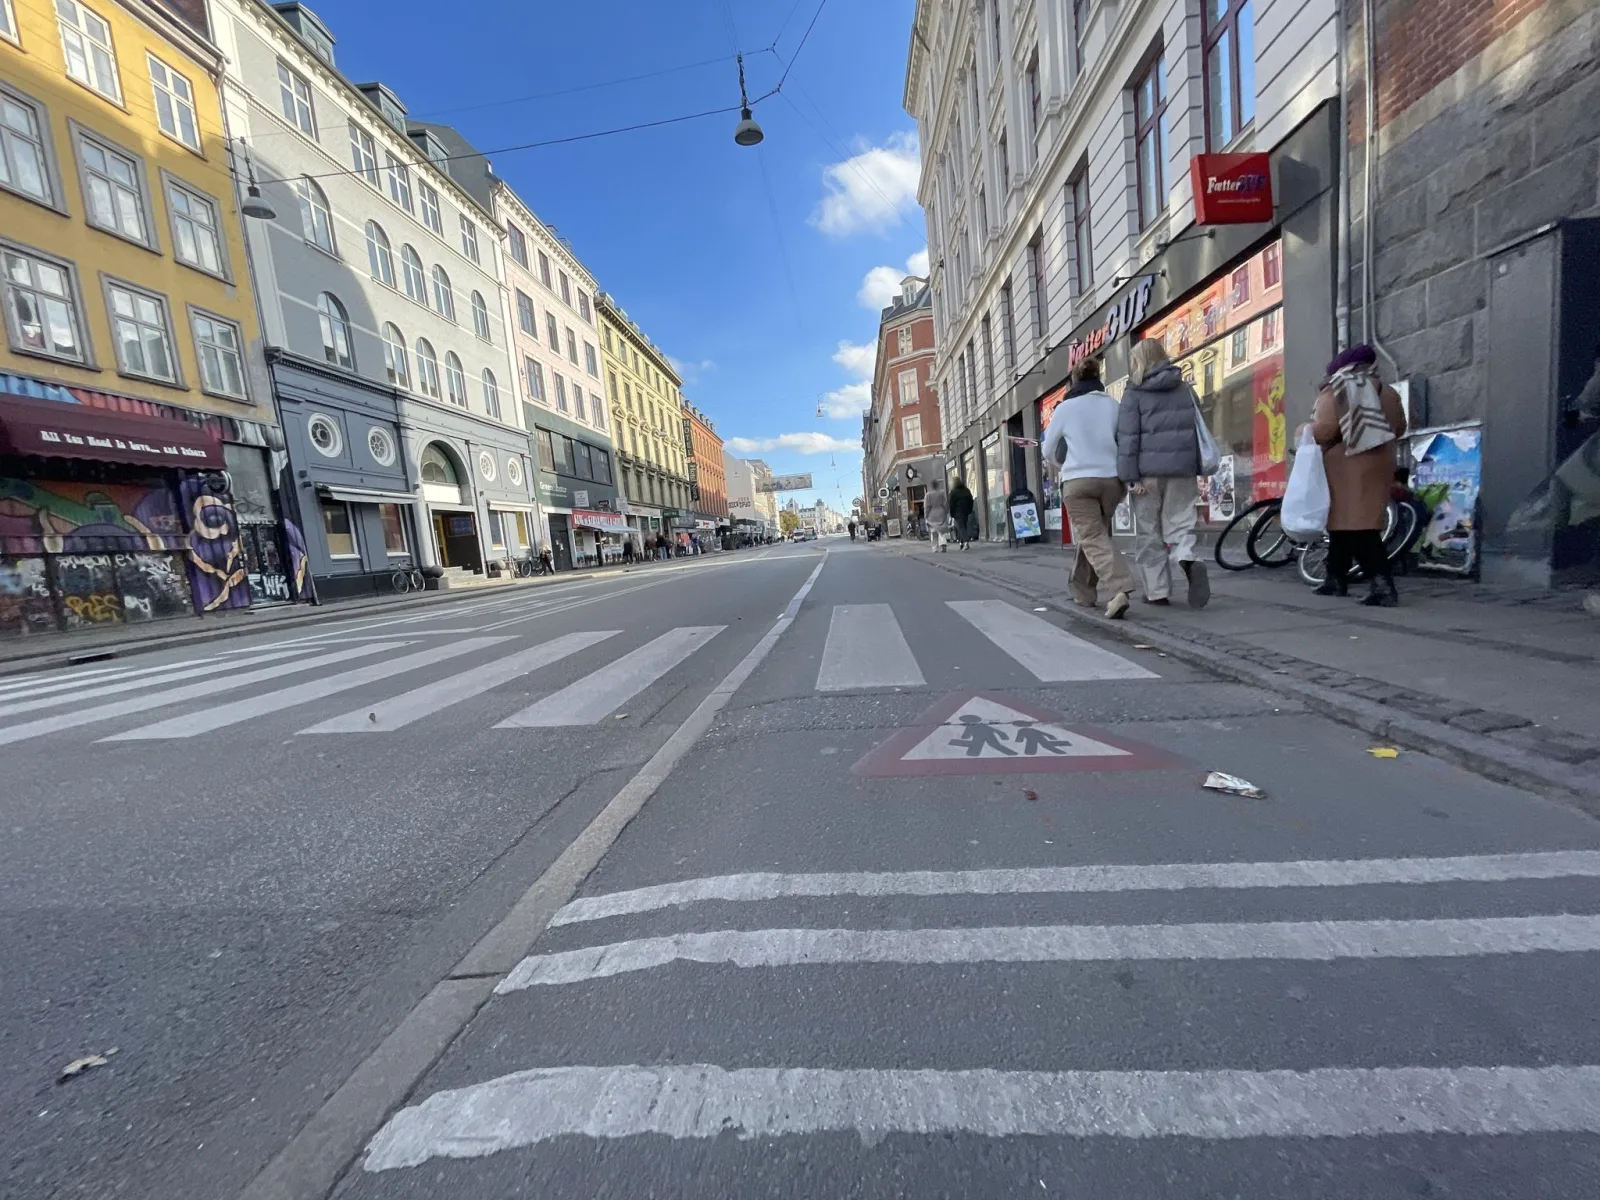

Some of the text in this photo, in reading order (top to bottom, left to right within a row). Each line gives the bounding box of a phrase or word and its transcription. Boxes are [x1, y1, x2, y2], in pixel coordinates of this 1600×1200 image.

[63, 433, 84, 445] You
[86, 435, 113, 448] Need
[683, 420, 693, 456] HOTEL
